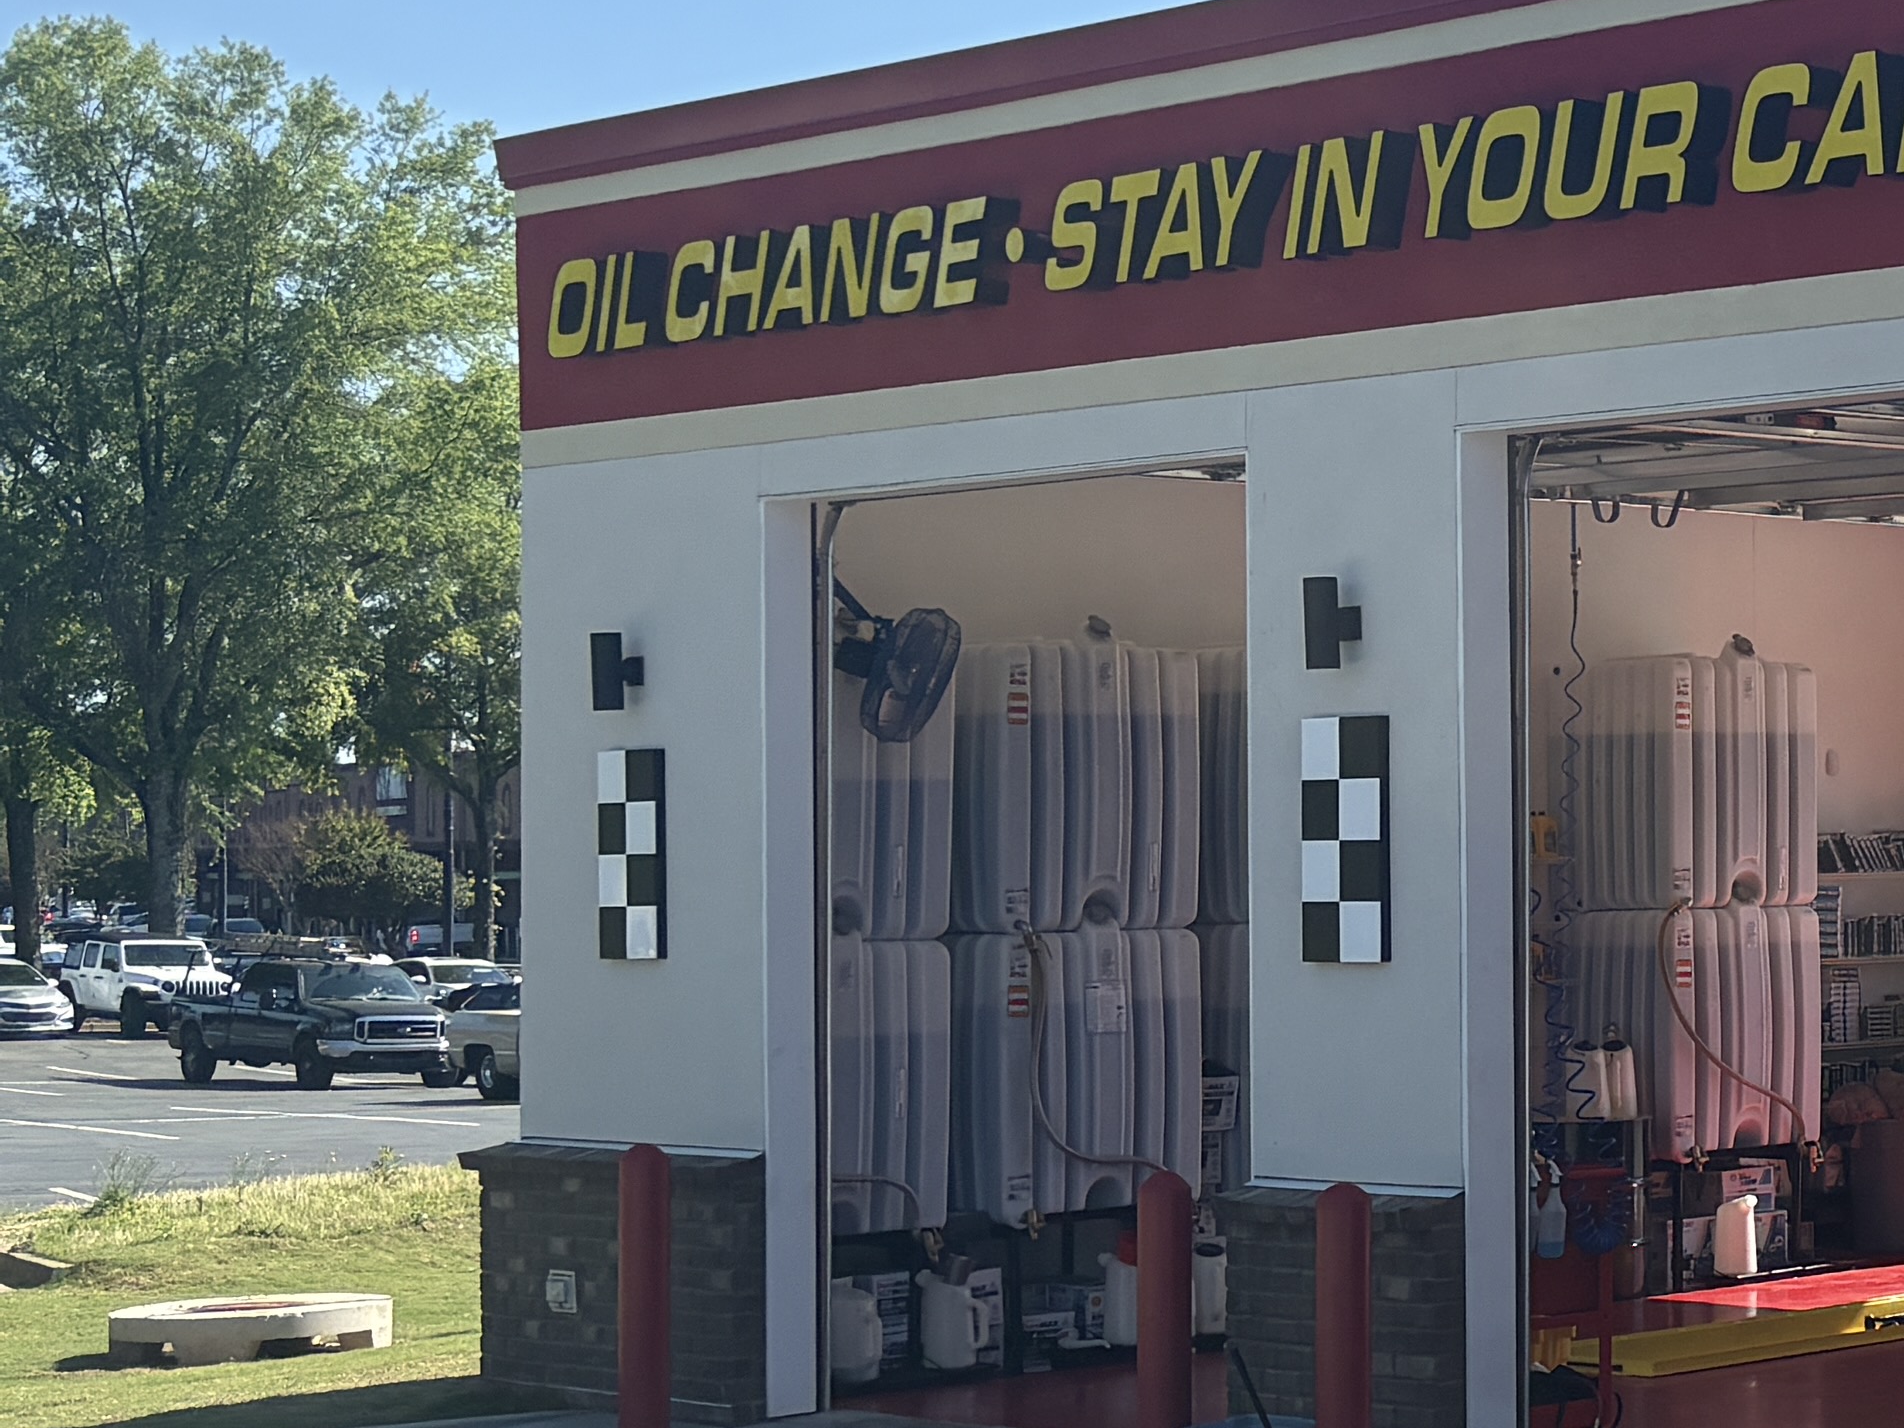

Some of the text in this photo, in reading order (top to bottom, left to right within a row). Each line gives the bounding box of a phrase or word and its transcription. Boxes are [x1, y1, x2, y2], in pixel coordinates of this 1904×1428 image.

[547, 244, 648, 359] OIL
[666, 193, 987, 344] CHANGE
[1044, 149, 1268, 293] STAY
[1283, 130, 1384, 261] IN
[1418, 78, 1702, 241] YOUR
